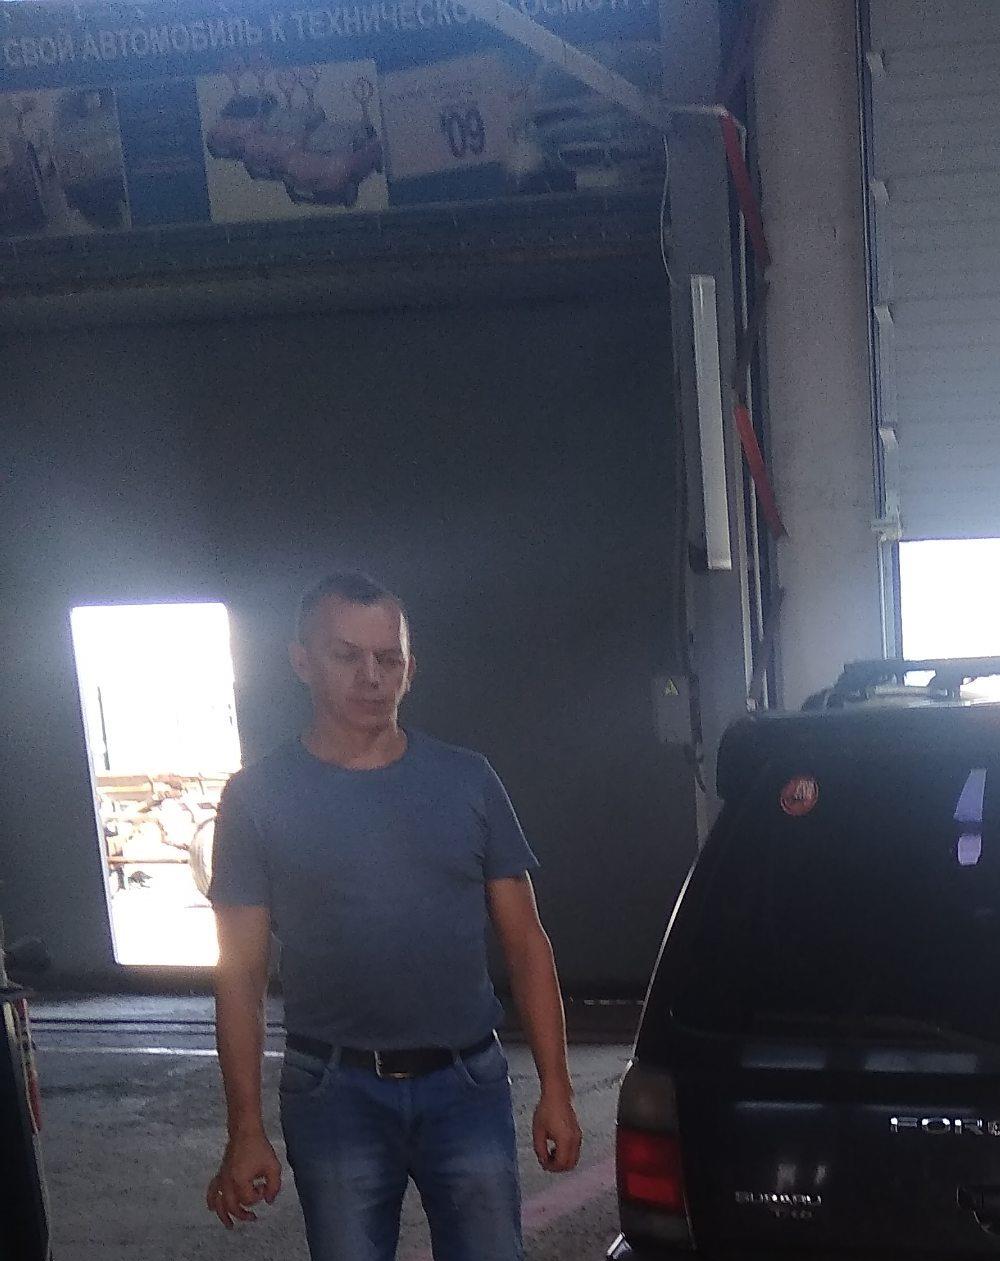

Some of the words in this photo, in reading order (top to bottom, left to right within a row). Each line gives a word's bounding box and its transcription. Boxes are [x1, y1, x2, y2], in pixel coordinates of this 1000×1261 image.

[3, 28, 76, 68] СВОЙ
[82, 16, 262, 61] АВТОМОБИЛЬ
[270, 13, 286, 43] К
[290, 0, 479, 40] ТЕХНИЧЕСКО
